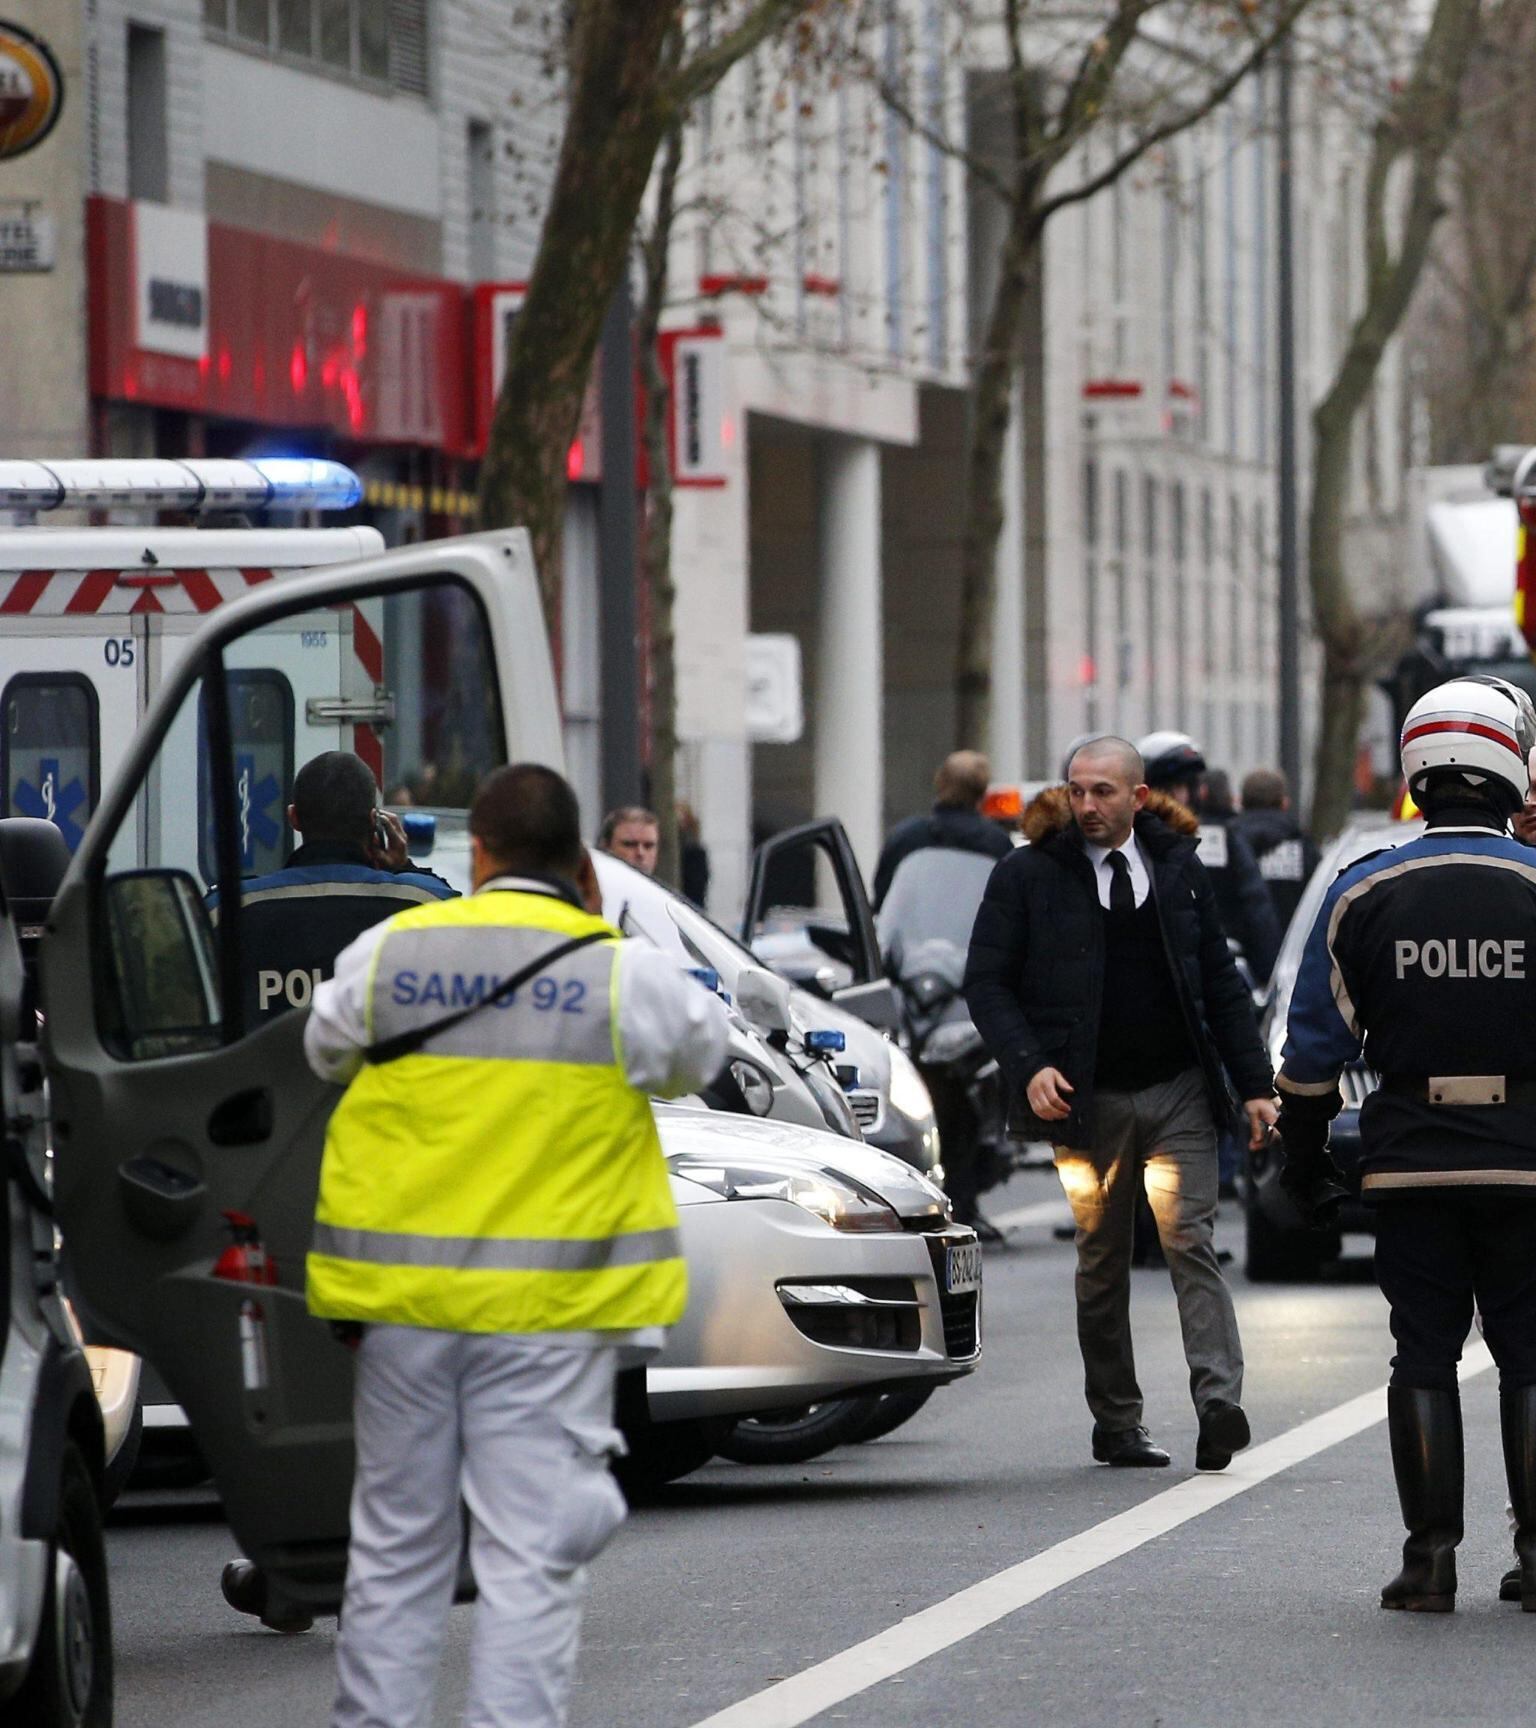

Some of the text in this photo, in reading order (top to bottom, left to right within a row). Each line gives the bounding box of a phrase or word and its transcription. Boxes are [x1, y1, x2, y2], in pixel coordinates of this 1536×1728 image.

[104, 638, 135, 667] 05
[1394, 938, 1526, 980] POLICE
[531, 977, 587, 1015] 92
